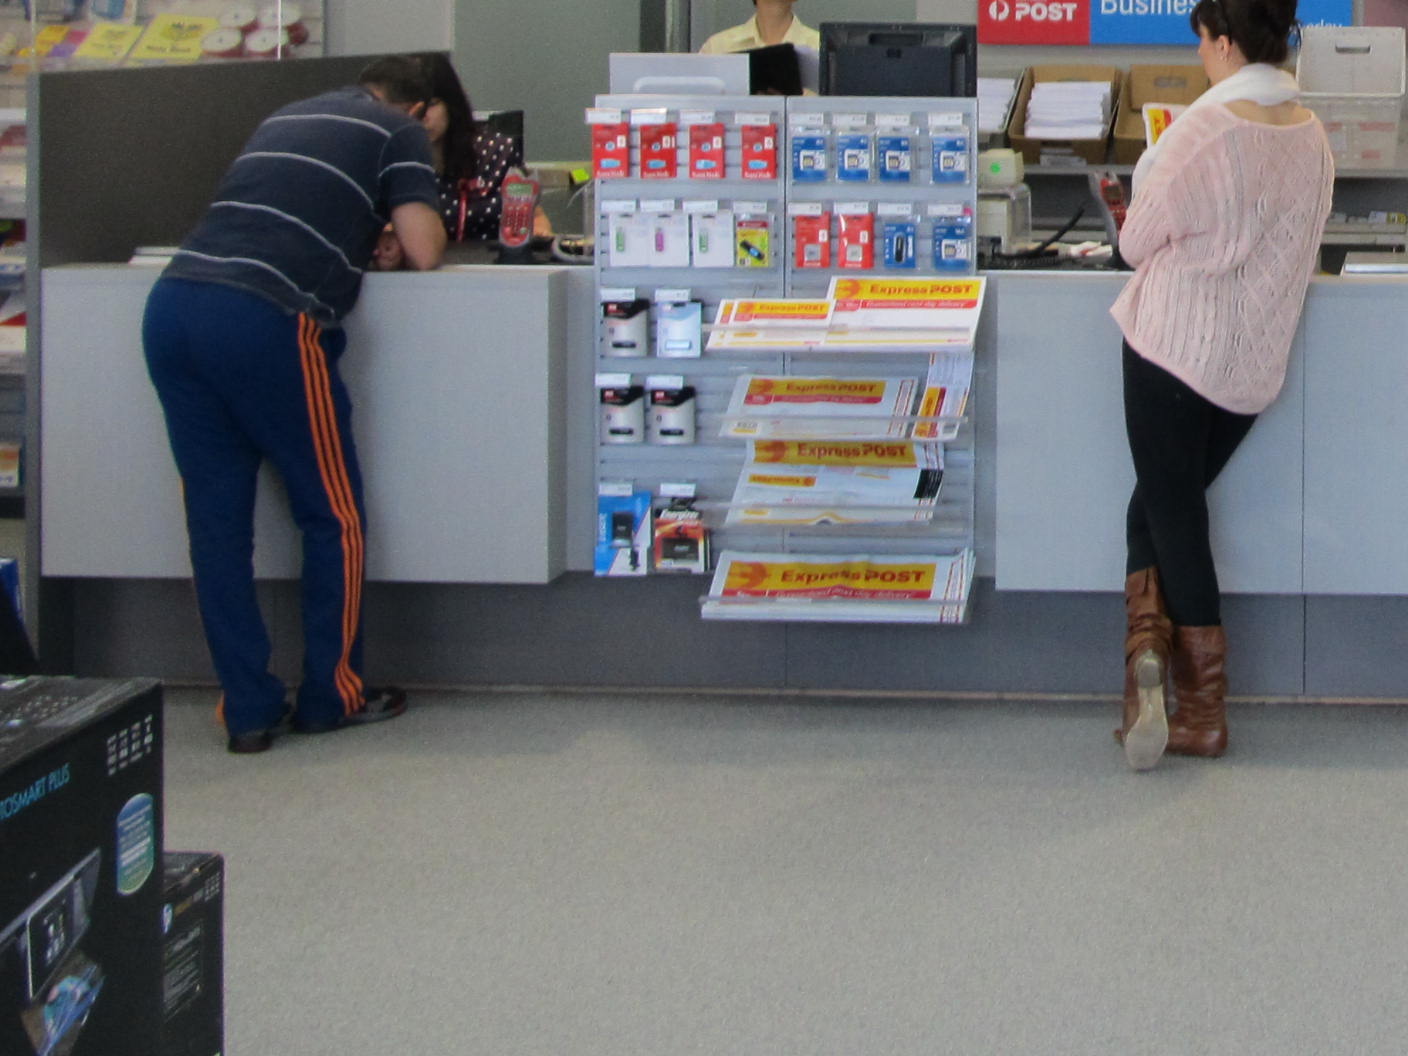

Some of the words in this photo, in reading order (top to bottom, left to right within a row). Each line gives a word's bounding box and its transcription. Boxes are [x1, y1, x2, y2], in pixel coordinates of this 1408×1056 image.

[1015, 2, 1077, 22] POST
[870, 284, 928, 297] Express
[929, 283, 974, 295] POST
[786, 382, 837, 394] Express
[837, 383, 877, 393] POST
[797, 443, 861, 460] Express
[862, 444, 907, 458] POST
[780, 569, 862, 585] Express
[863, 570, 926, 583] POST
[49, 761, 71, 791] PLUS
